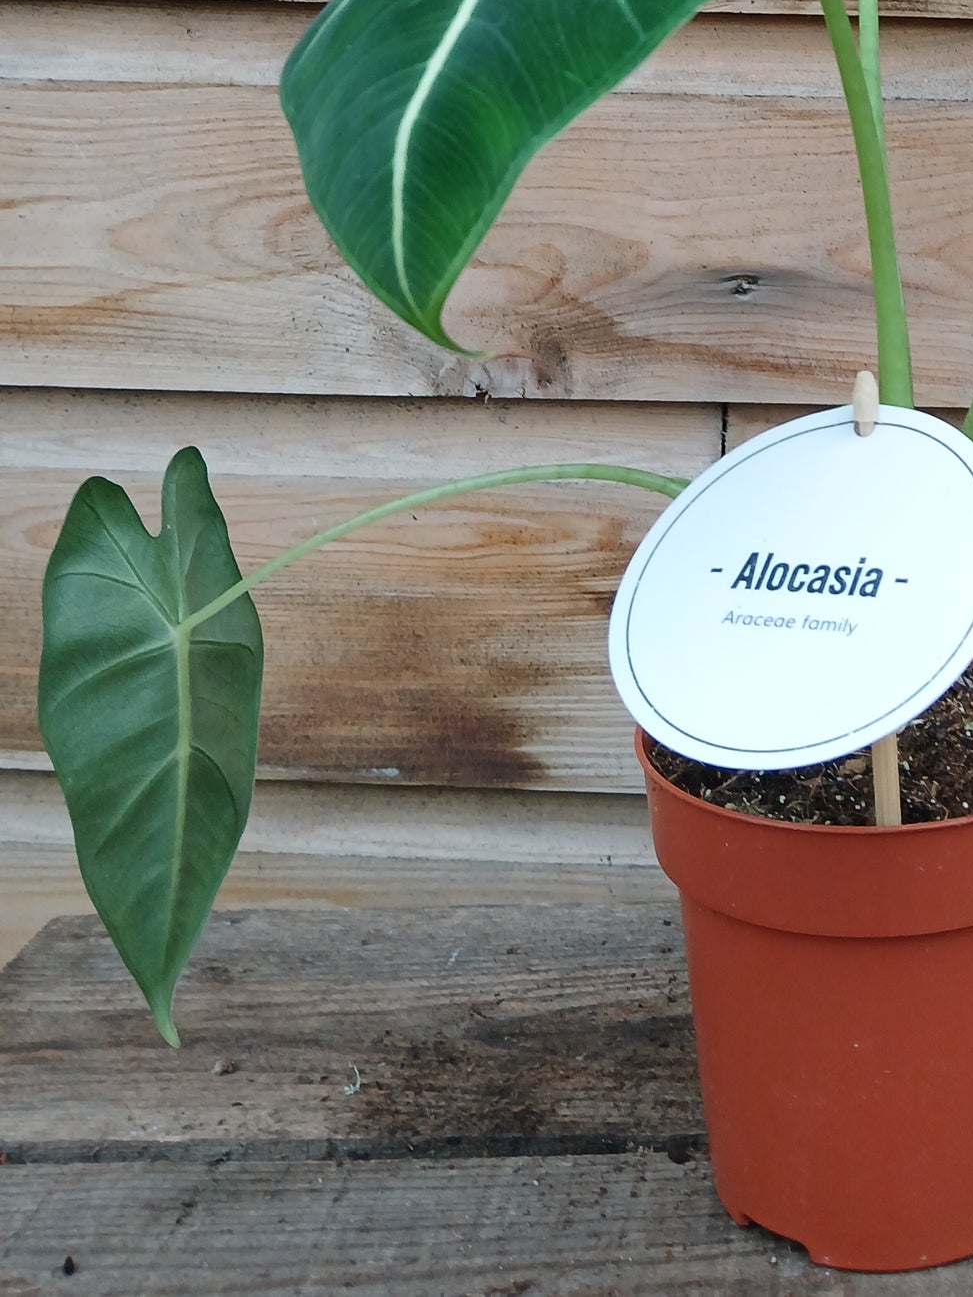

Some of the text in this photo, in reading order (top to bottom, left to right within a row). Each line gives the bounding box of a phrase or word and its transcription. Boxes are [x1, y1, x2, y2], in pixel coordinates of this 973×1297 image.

[730, 551, 884, 598] Alocasia
[721, 610, 858, 637] Araceae family
